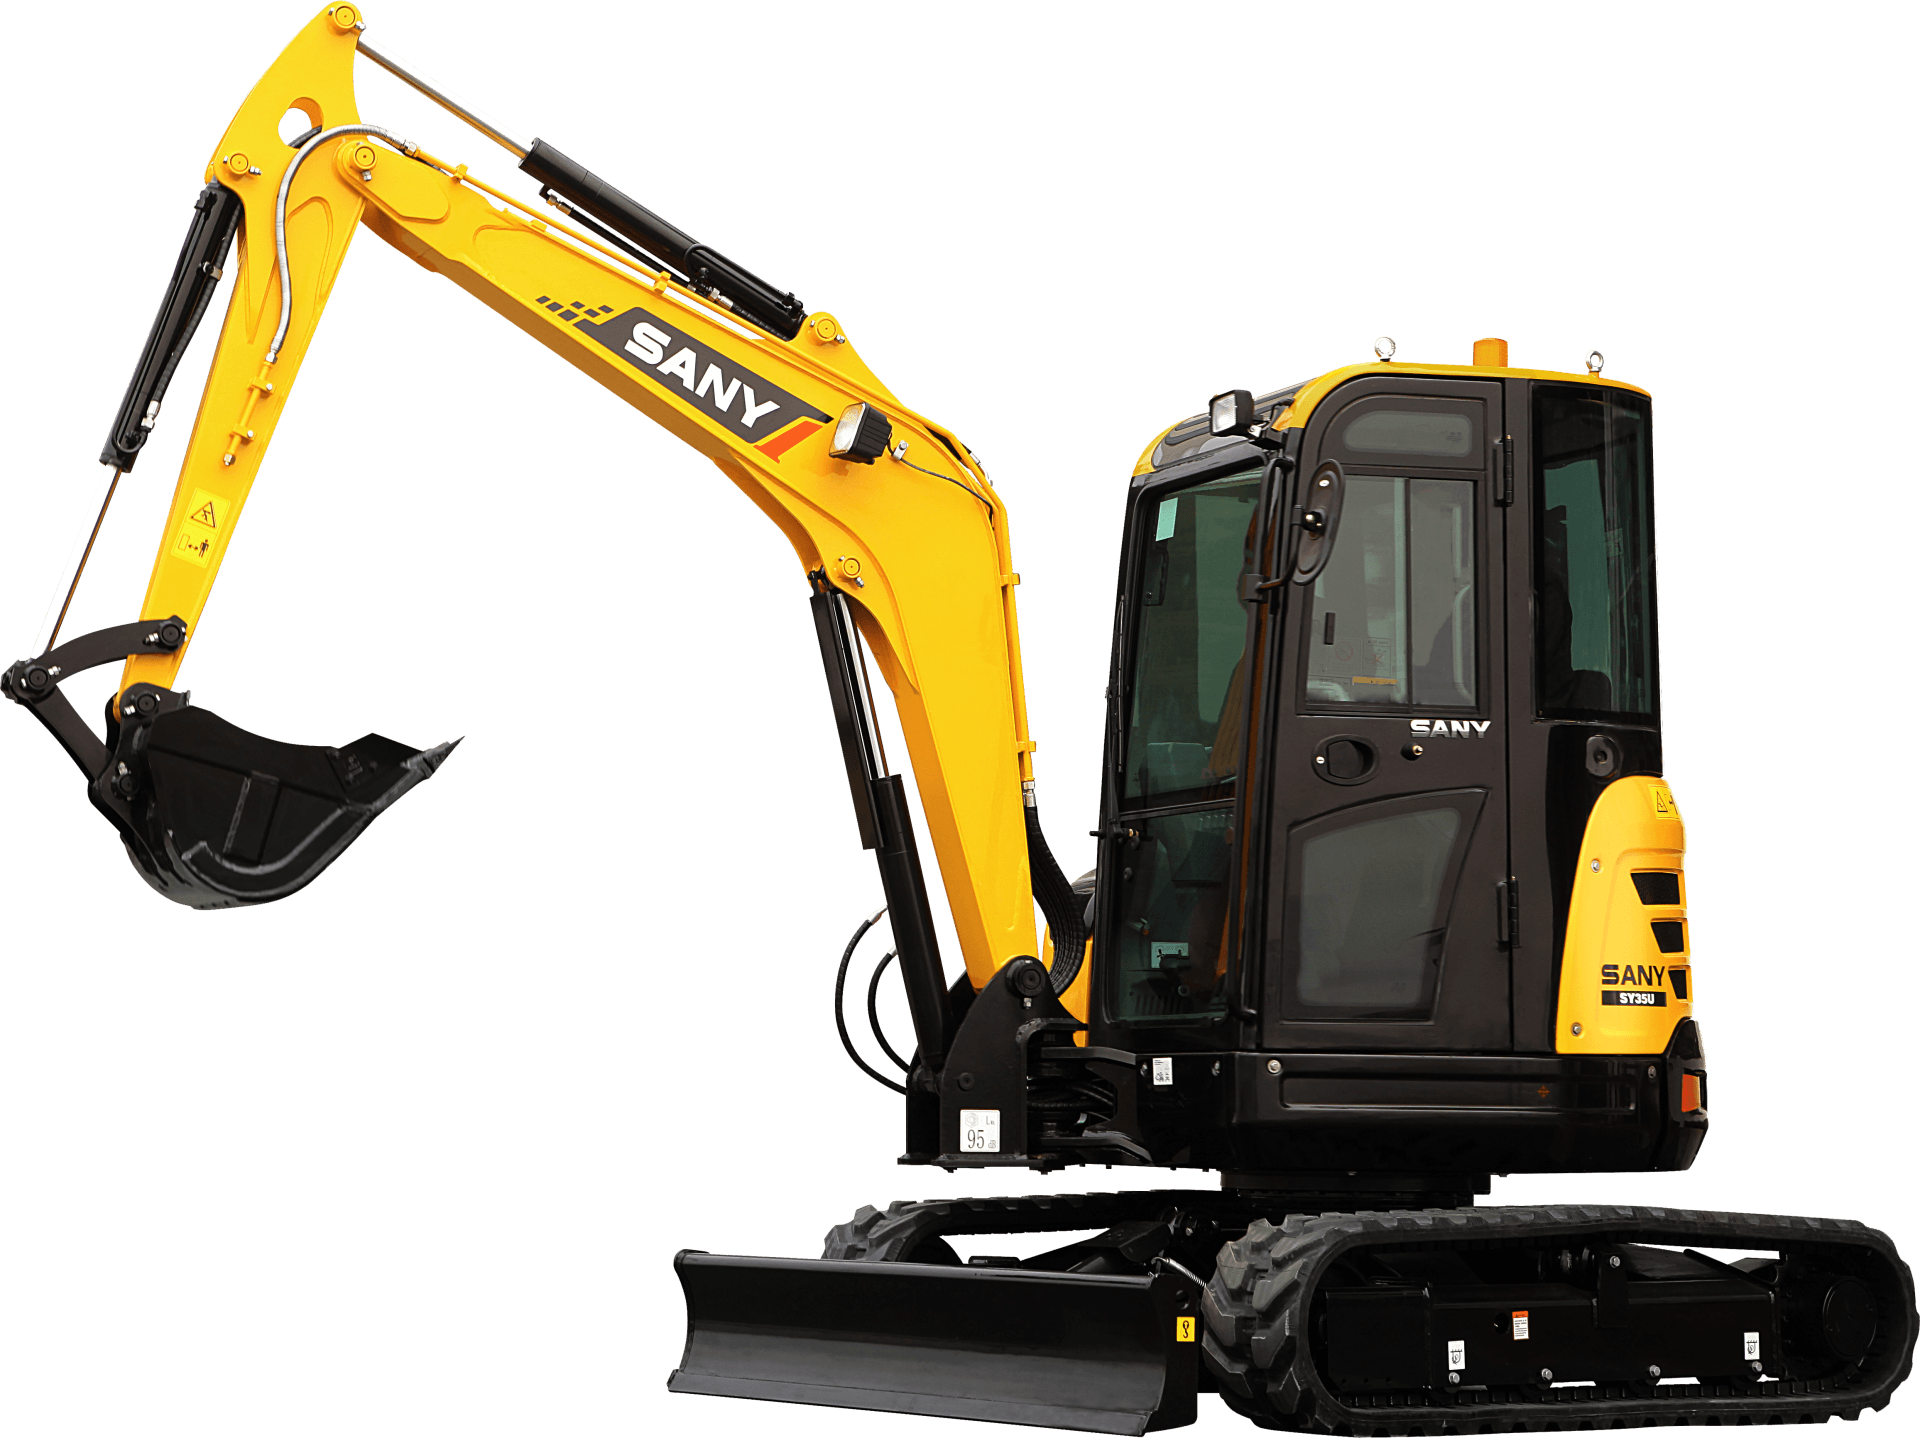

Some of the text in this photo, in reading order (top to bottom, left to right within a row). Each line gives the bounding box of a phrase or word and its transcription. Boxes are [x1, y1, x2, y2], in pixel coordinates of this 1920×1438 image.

[624, 321, 780, 428] SANY
[1410, 719, 1491, 738] SANY
[1601, 964, 1665, 986] SANY
[1619, 992, 1655, 1004] SY35U
[967, 1129, 985, 1149] 95
